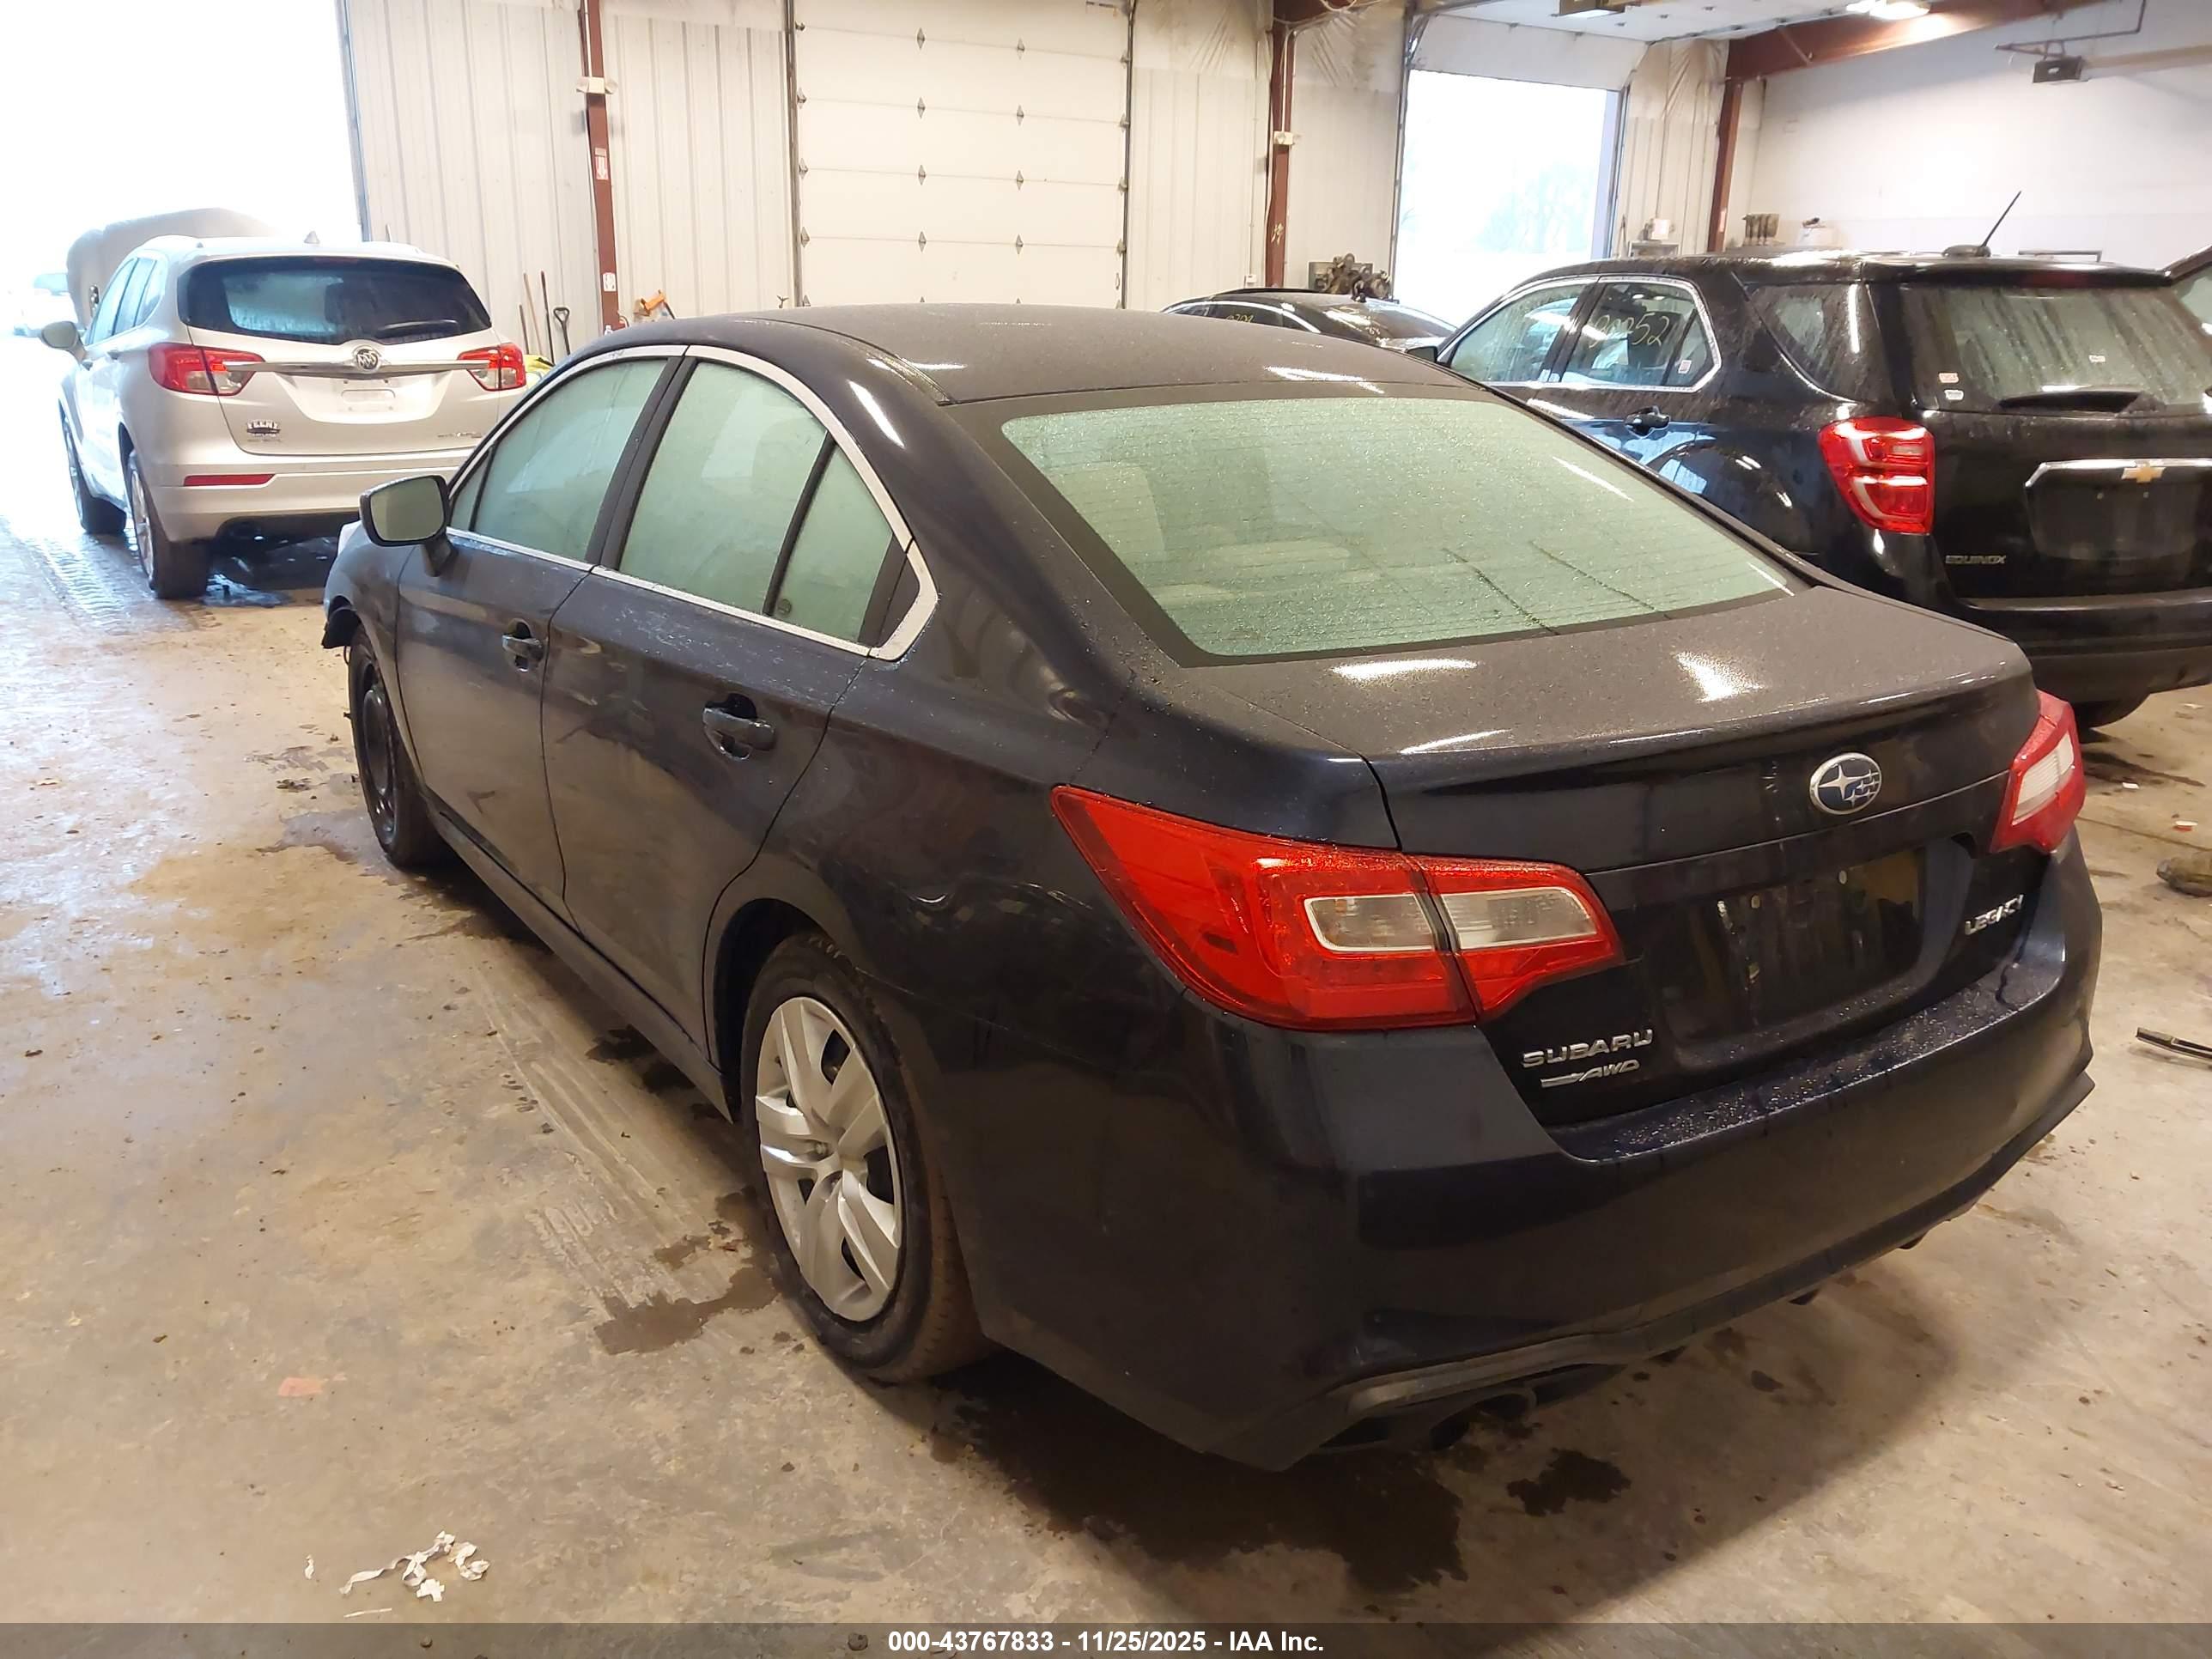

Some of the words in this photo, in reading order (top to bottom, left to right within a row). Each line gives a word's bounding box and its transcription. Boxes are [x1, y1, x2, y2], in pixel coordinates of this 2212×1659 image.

[1945, 555, 2007, 564] EQUINOX
[1964, 894, 2024, 935] LEGACY
[1522, 1028, 1653, 1068] SUBARU
[1577, 1059, 1641, 1082] AWD
